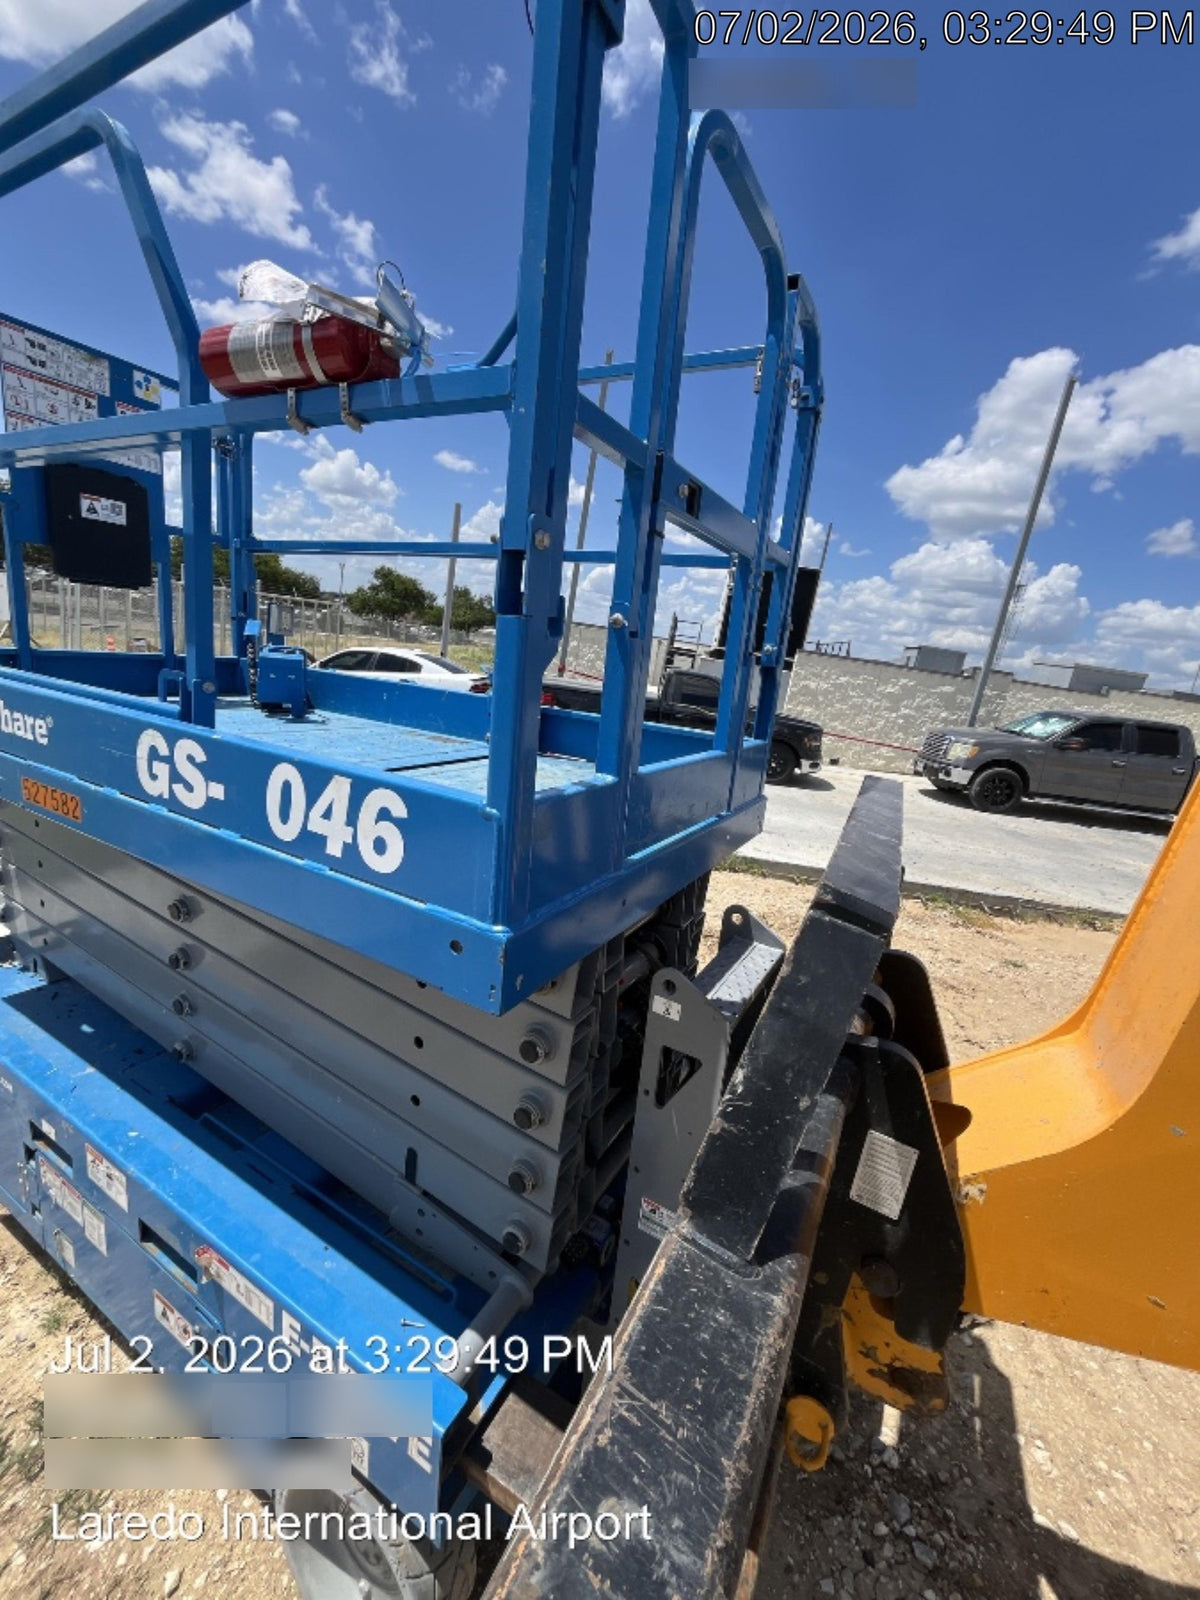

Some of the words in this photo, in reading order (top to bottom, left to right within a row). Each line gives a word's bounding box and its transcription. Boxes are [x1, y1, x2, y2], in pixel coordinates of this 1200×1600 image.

[23, 777, 80, 821] 527582
[136, 728, 225, 810] GS-
[266, 762, 409, 874] 046
